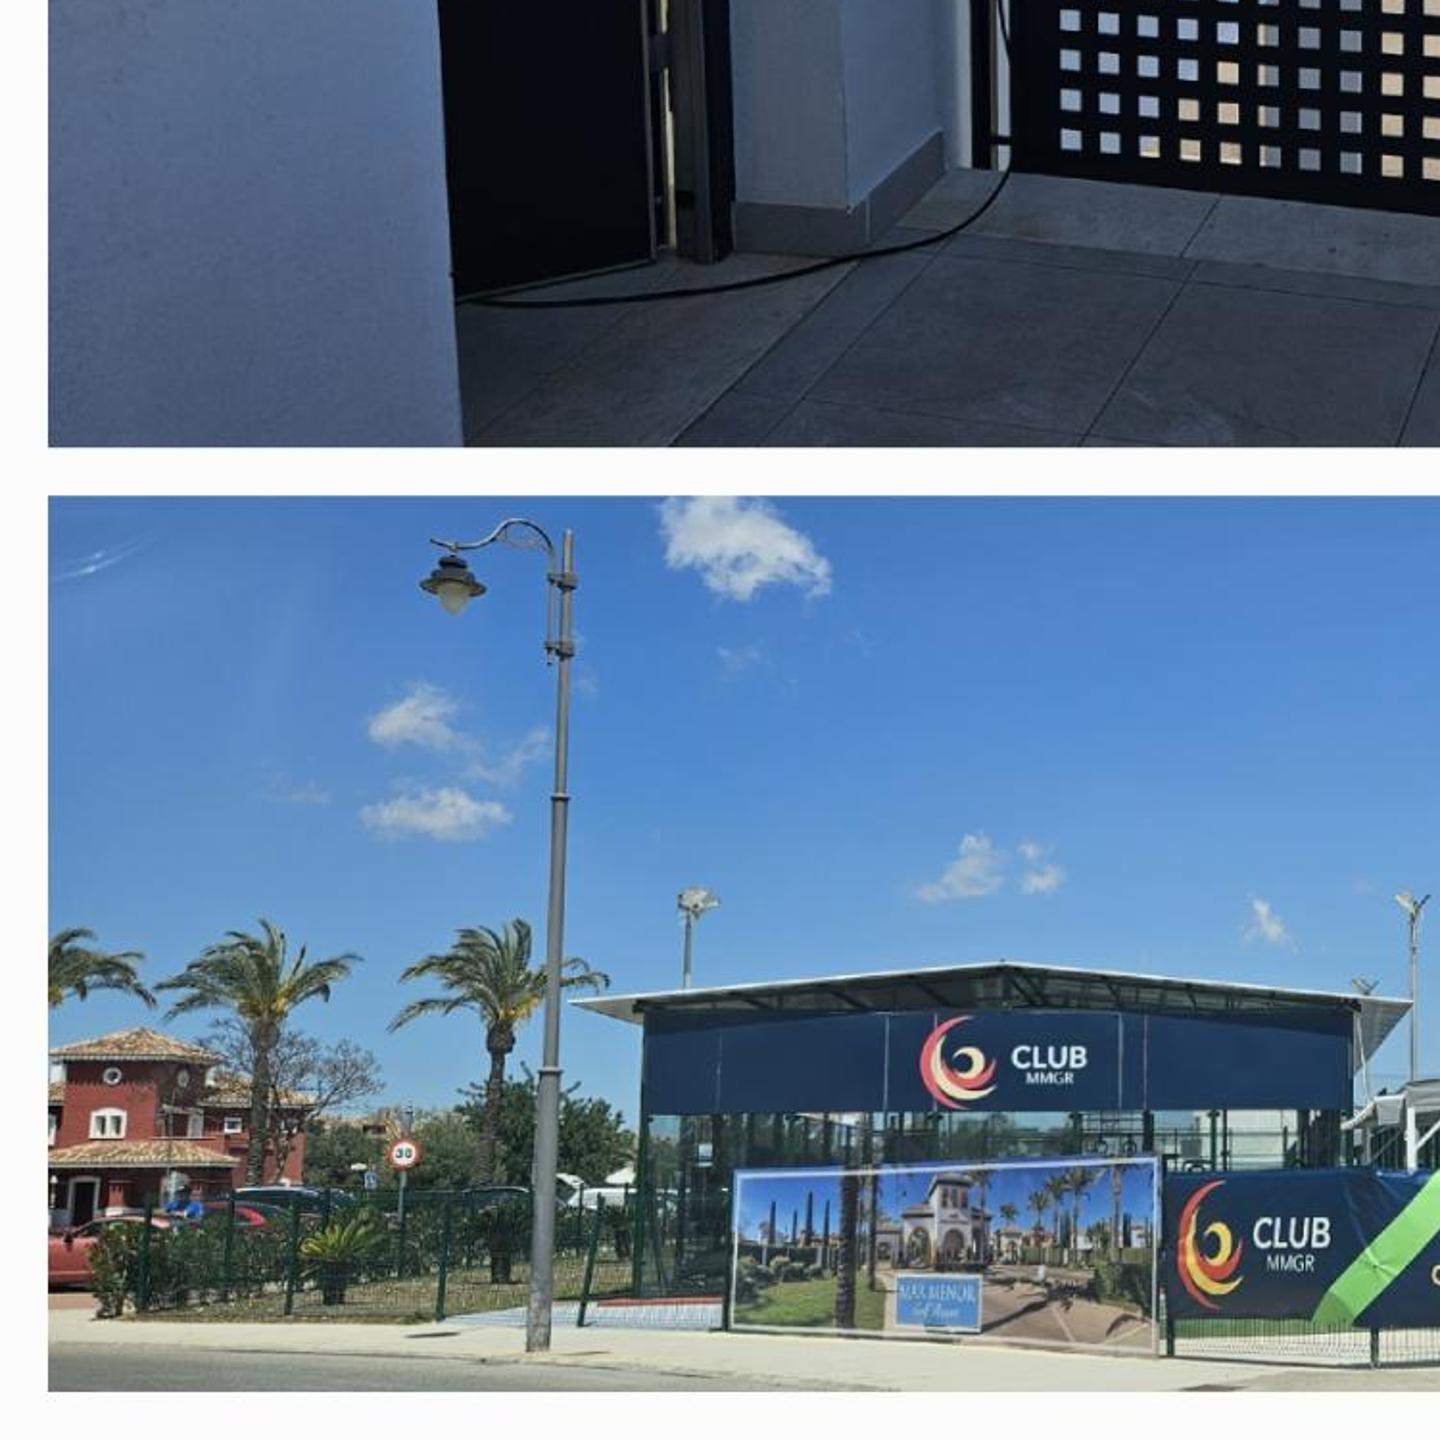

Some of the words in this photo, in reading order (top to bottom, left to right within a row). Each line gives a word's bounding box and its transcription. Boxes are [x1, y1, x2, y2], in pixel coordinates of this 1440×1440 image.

[1010, 1045, 1088, 1070] CLUB
[1025, 1071, 1075, 1085] MMGR
[1253, 1216, 1331, 1249] CLUB
[1266, 1254, 1315, 1273] MMGR
